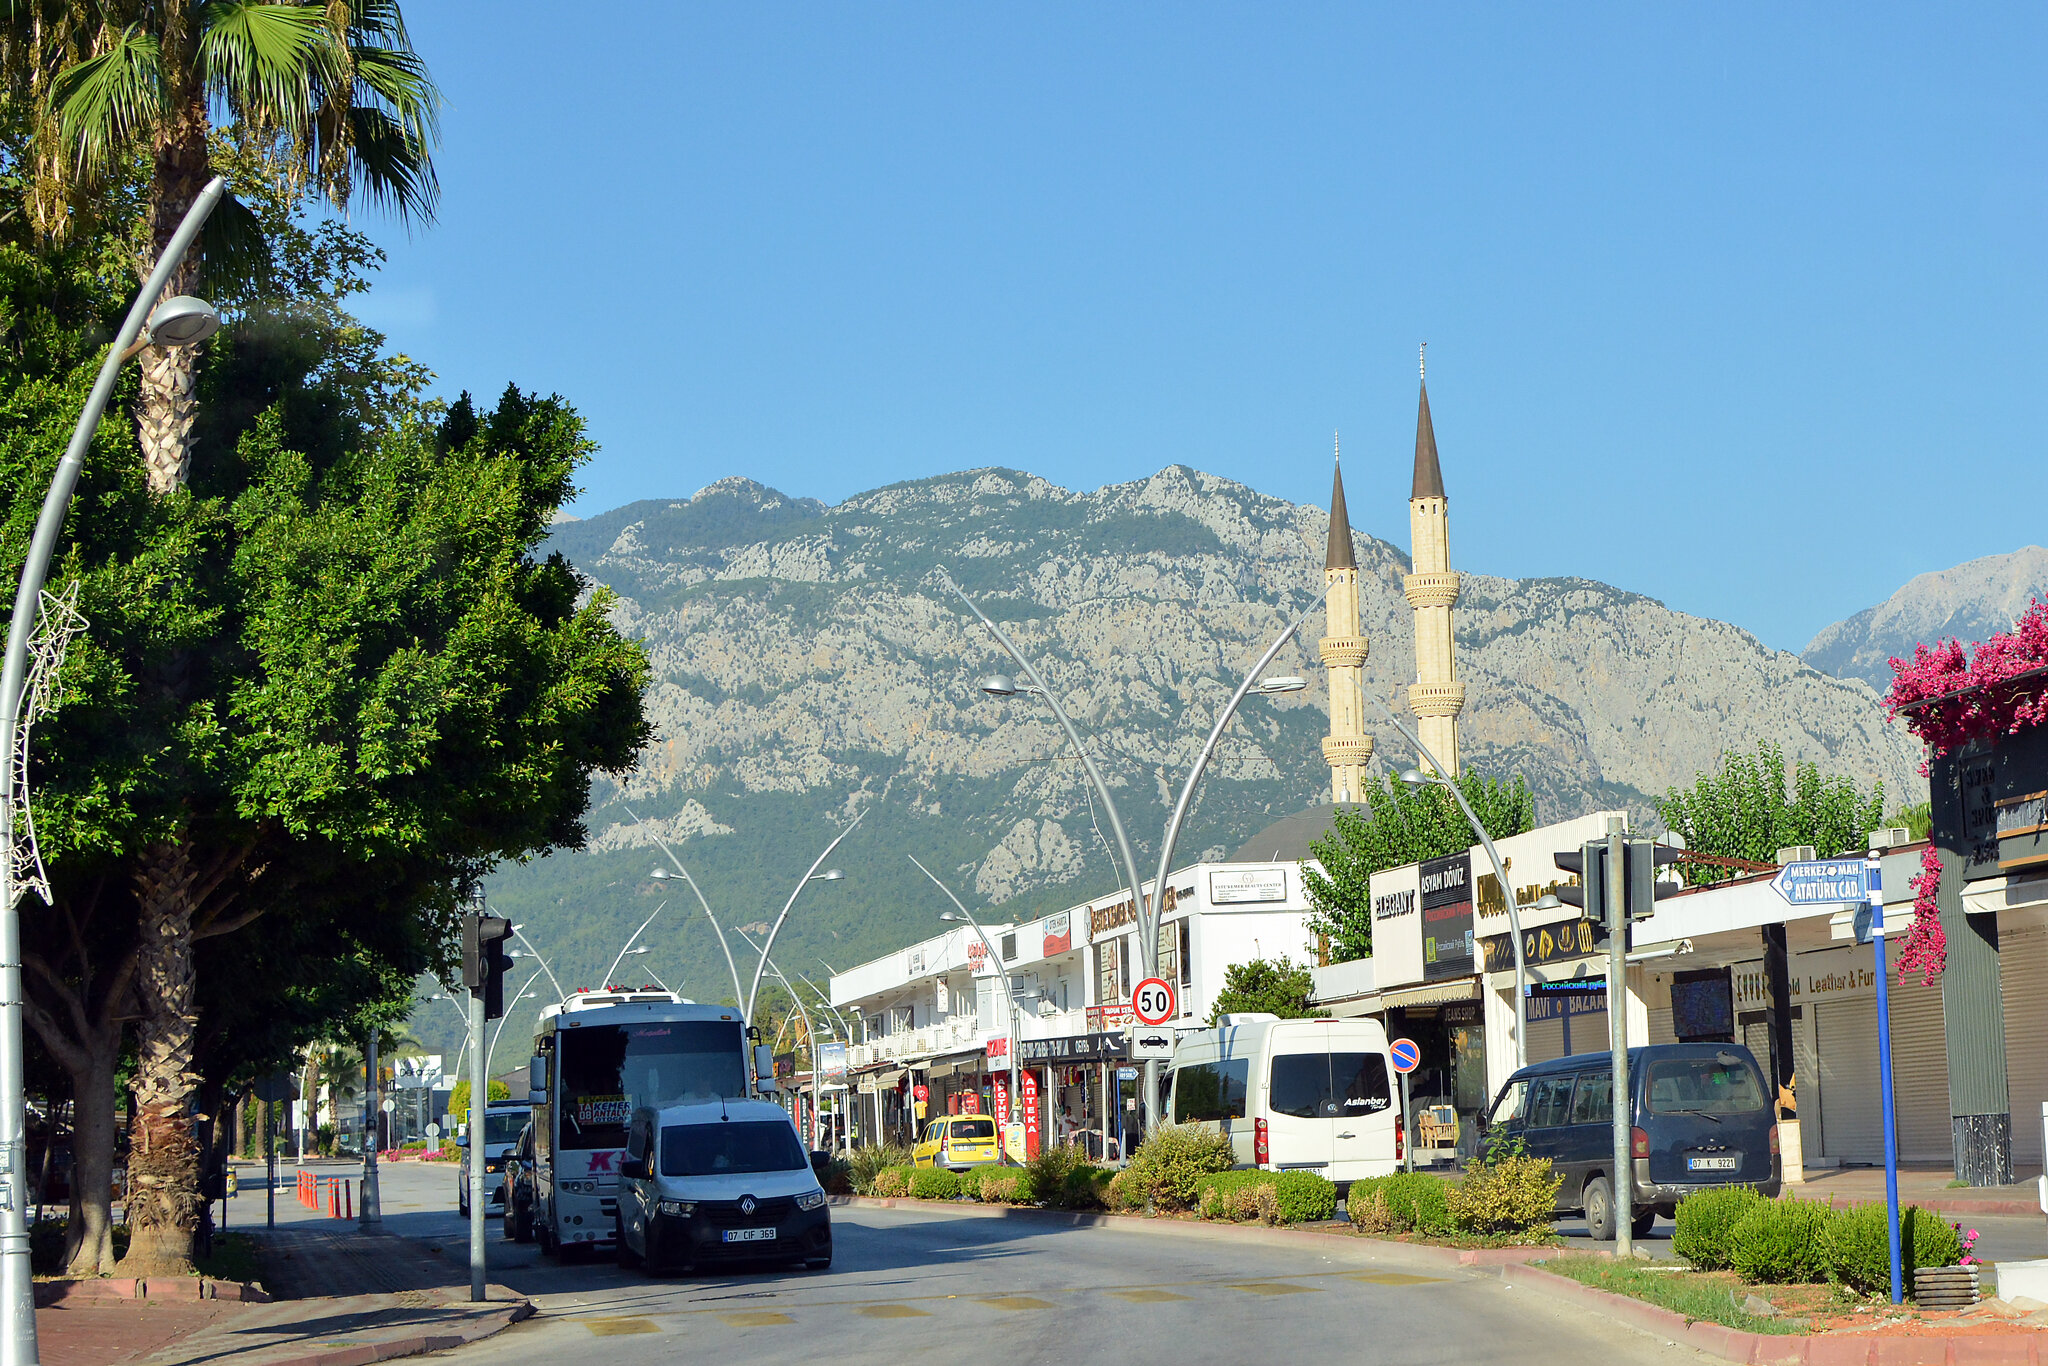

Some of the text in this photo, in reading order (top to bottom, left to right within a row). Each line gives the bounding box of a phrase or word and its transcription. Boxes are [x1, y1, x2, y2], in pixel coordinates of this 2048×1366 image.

[1421, 863, 1464, 894] ASYAM DÖVİZ
[1791, 864, 1862, 878] MERKEZ MAH.
[1795, 878, 1861, 900] ATATÜRK CAD.
[1375, 889, 1415, 920] ELEGANT
[1542, 980, 1588, 990] Российский
[1809, 973, 1847, 993] Leather
[1848, 970, 1856, 988] &
[1141, 991, 1167, 1012] 50
[594, 1101, 631, 1111] KEMER
[1026, 1078, 1037, 1133] АПТЕКА
[1692, 1159, 1701, 1168] 07
[1717, 1159, 1734, 1167] 9221
[728, 1229, 774, 1241] 07 CIF 369
